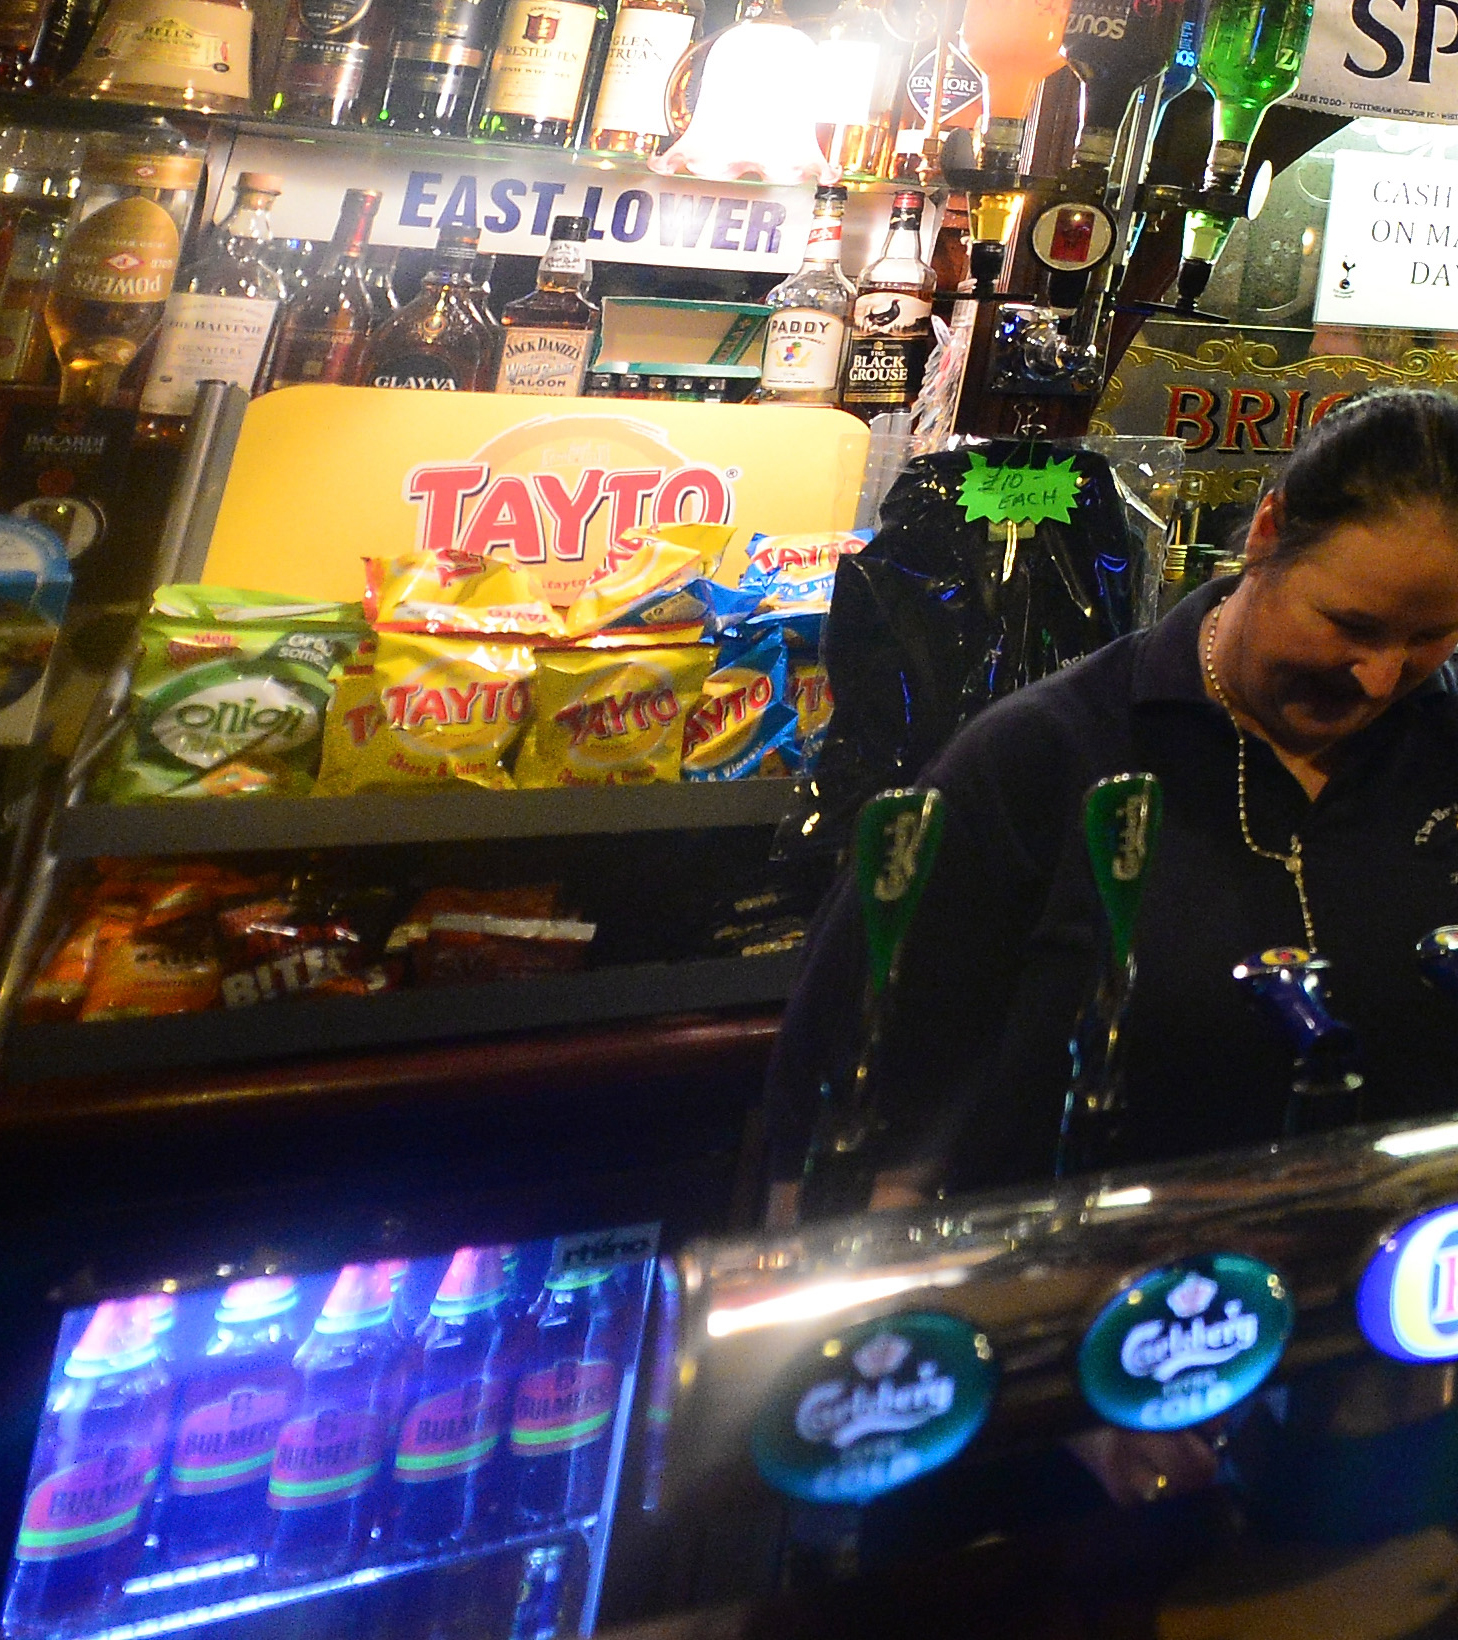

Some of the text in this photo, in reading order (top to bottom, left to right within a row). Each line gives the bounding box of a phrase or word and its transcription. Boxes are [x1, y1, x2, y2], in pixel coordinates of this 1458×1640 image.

[611, 34, 655, 49] GLEN
[398, 171, 787, 256] EAST LOWER
[1371, 220, 1418, 247] ON
[194, 320, 264, 335] BALVENIE
[770, 320, 831, 339] PADDY
[504, 341, 536, 361] JACK
[851, 355, 907, 369] BLACK
[374, 375, 457, 392] GLAYVA
[848, 367, 909, 383] GROUSE
[998, 490, 1058, 510] EACH
[408, 463, 732, 565] TAYTO
[380, 678, 532, 727] TAYTO
[556, 687, 681, 746] TAYTO
[681, 674, 774, 755] AYTO
[1121, 1304, 1259, 1377] Carlsberg
[796, 1364, 956, 1437] Carlsberg
